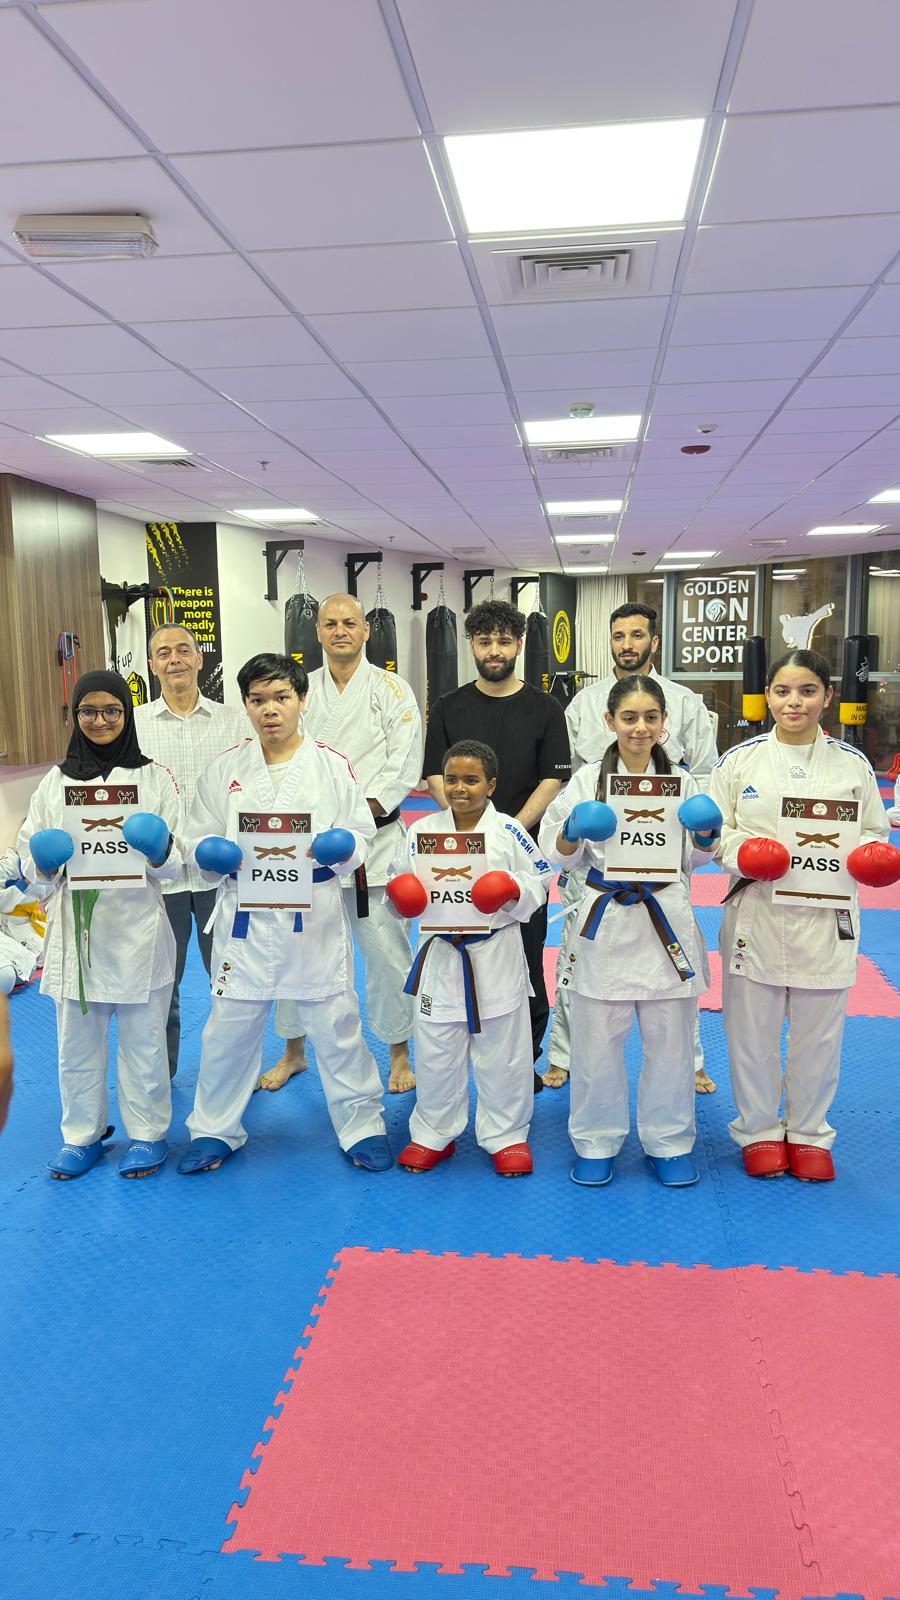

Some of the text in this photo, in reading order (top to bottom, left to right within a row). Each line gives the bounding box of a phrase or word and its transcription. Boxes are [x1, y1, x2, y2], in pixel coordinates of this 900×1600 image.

[171, 586, 214, 597] There is
[683, 578, 749, 597] GOLDEN
[184, 610, 213, 619] more
[194, 631, 216, 642] han
[681, 625, 747, 643] CENTER
[121, 651, 133, 668] up
[681, 645, 744, 665] SPORT
[504, 823, 535, 855] SENSHI
[619, 831, 667, 847] PASS
[81, 841, 129, 855] PASS
[790, 855, 841, 873] PASS
[251, 868, 299, 882] PASS
